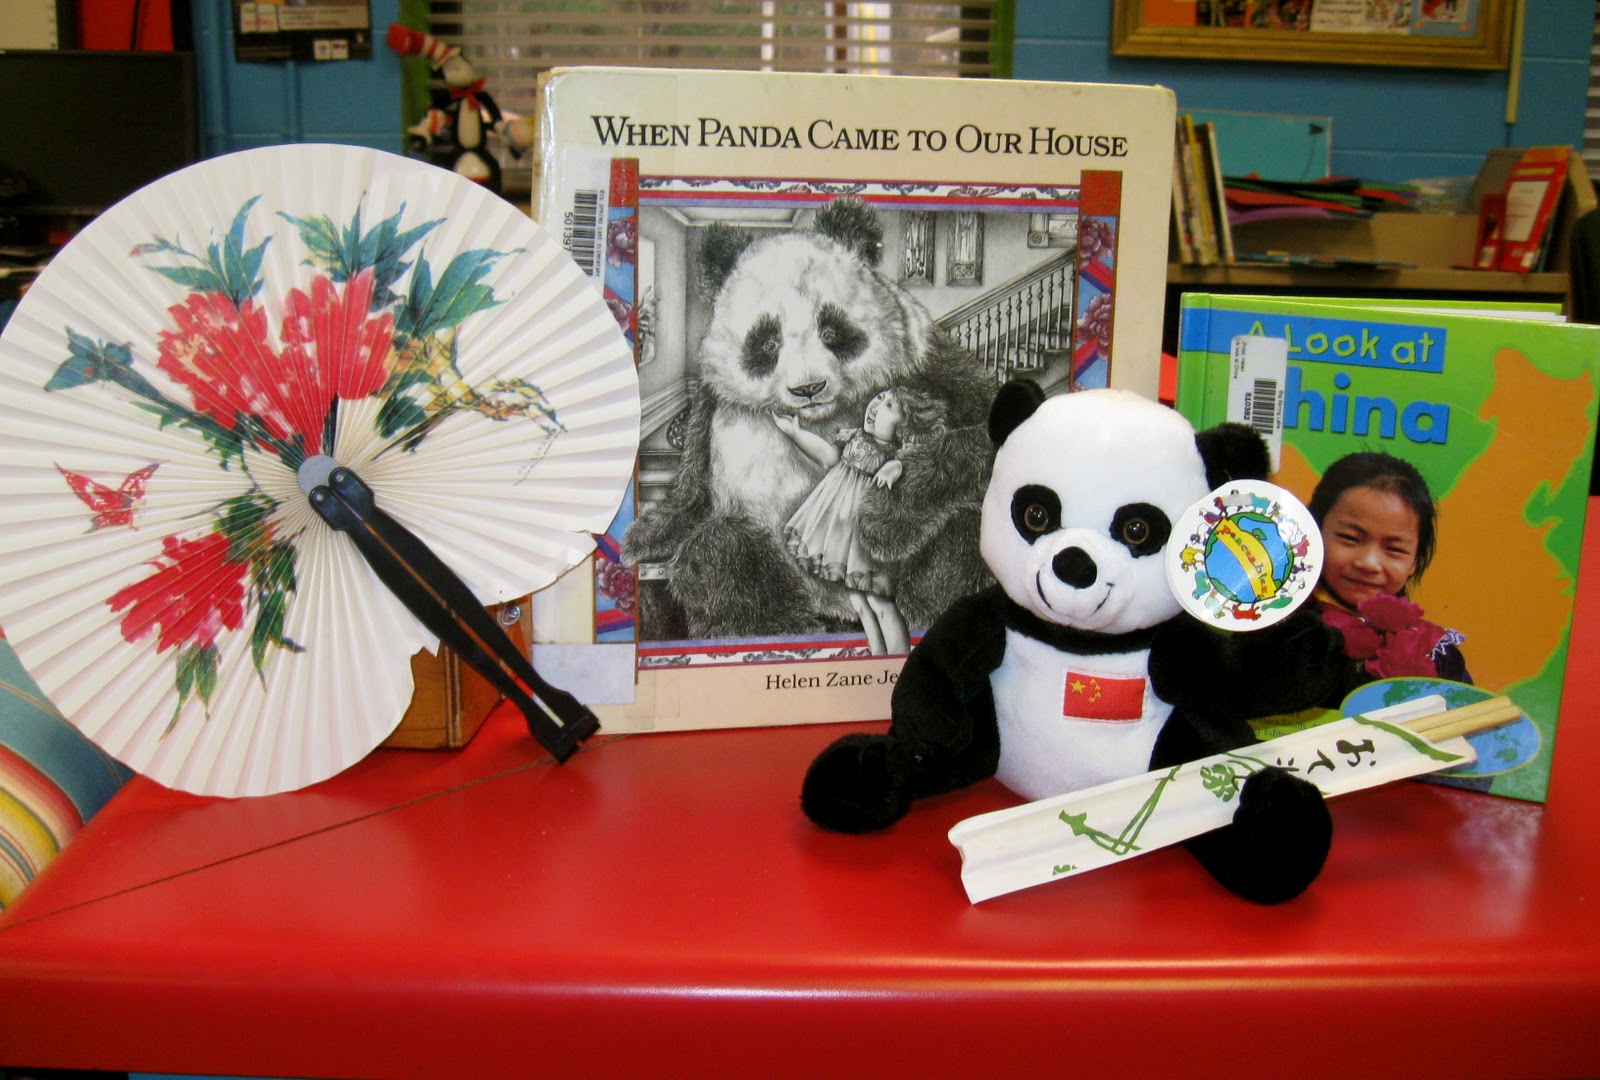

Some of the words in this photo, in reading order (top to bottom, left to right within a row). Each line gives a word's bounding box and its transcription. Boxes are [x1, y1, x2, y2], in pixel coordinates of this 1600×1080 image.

[591, 115, 691, 147] WHEN
[697, 117, 802, 149] PANDA
[807, 118, 900, 150] CAME
[906, 129, 947, 151] TO
[955, 123, 1023, 153] OUR
[1028, 126, 1129, 157] HOUSE
[563, 211, 574, 252] 501397
[1284, 323, 1380, 360] Look
[1391, 332, 1436, 365] at
[1243, 391, 1252, 421] 510382
[1282, 365, 1450, 445] hina
[765, 673, 821, 690] Helen
[826, 671, 873, 687] Zane
[877, 669, 900, 685] Je
[1276, 739, 1375, 774] おて
